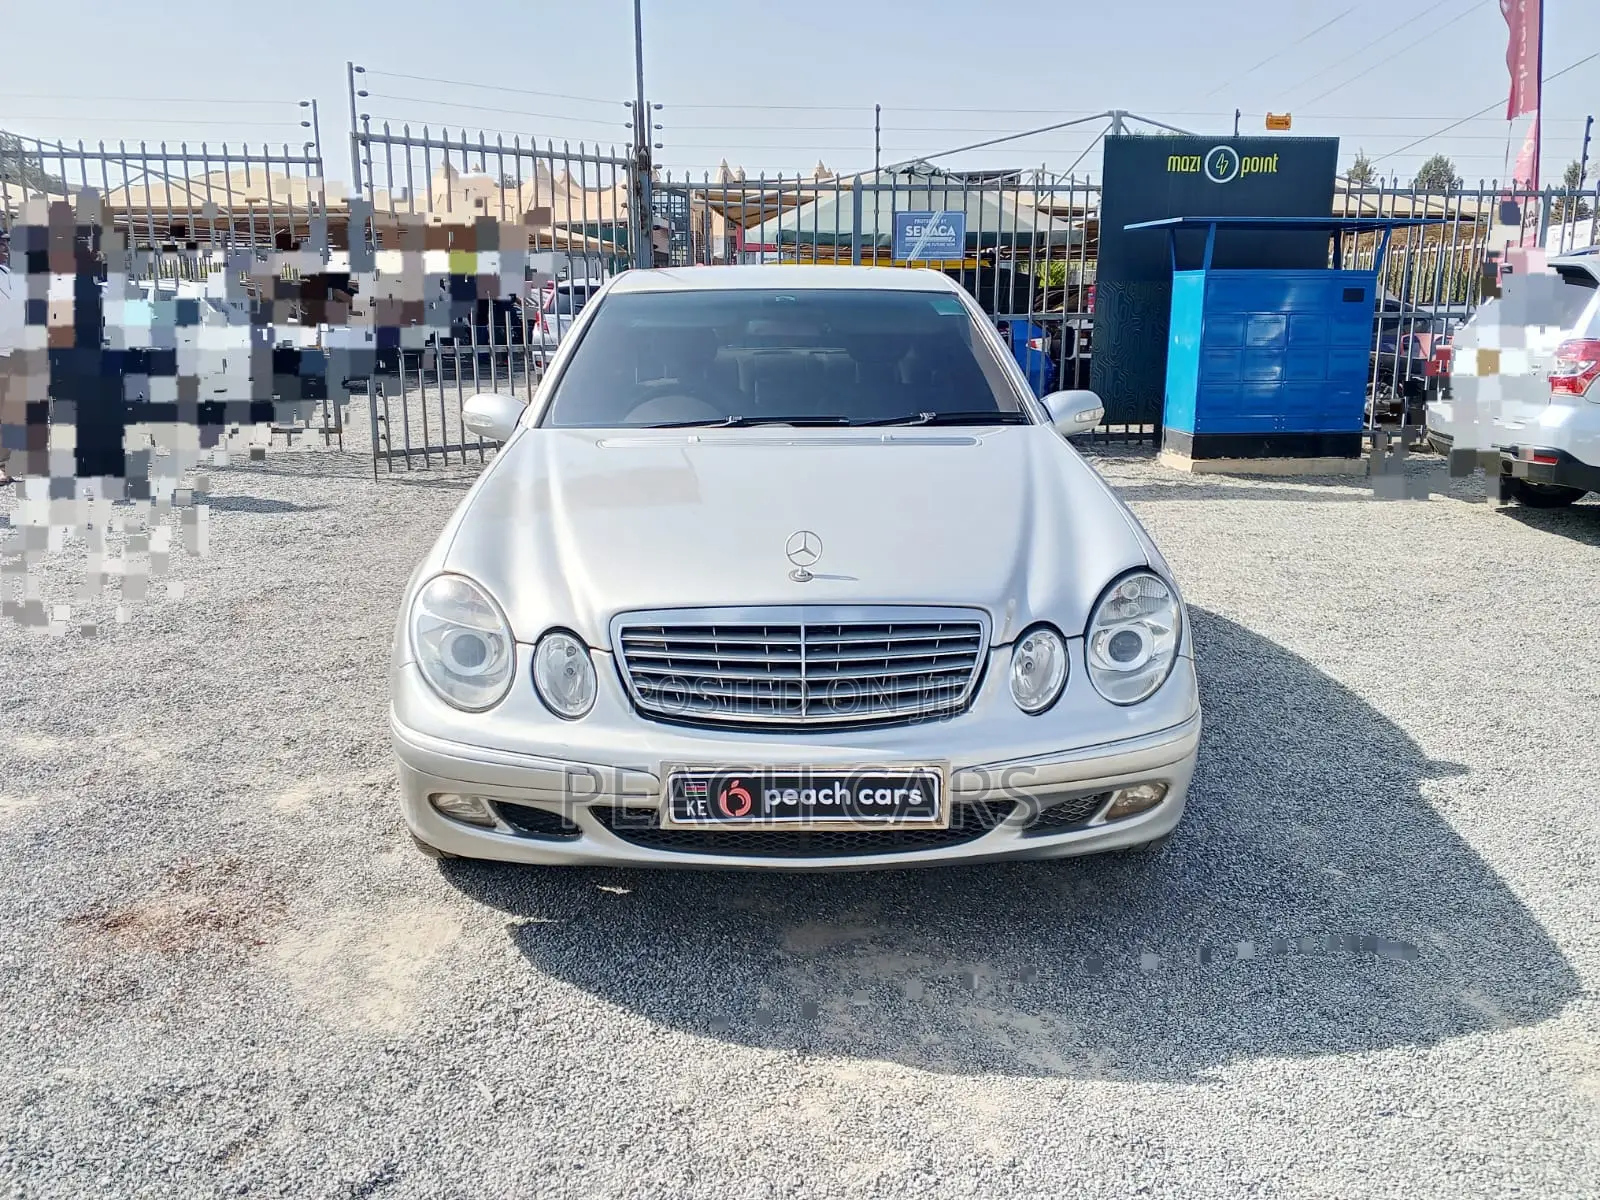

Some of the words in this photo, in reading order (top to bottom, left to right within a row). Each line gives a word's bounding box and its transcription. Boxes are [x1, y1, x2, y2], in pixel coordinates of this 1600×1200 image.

[1167, 155, 1201, 172] mazi
[1240, 153, 1279, 178] point
[686, 800, 706, 816] KE
[765, 781, 850, 813] peach
[858, 789, 922, 805] cars
